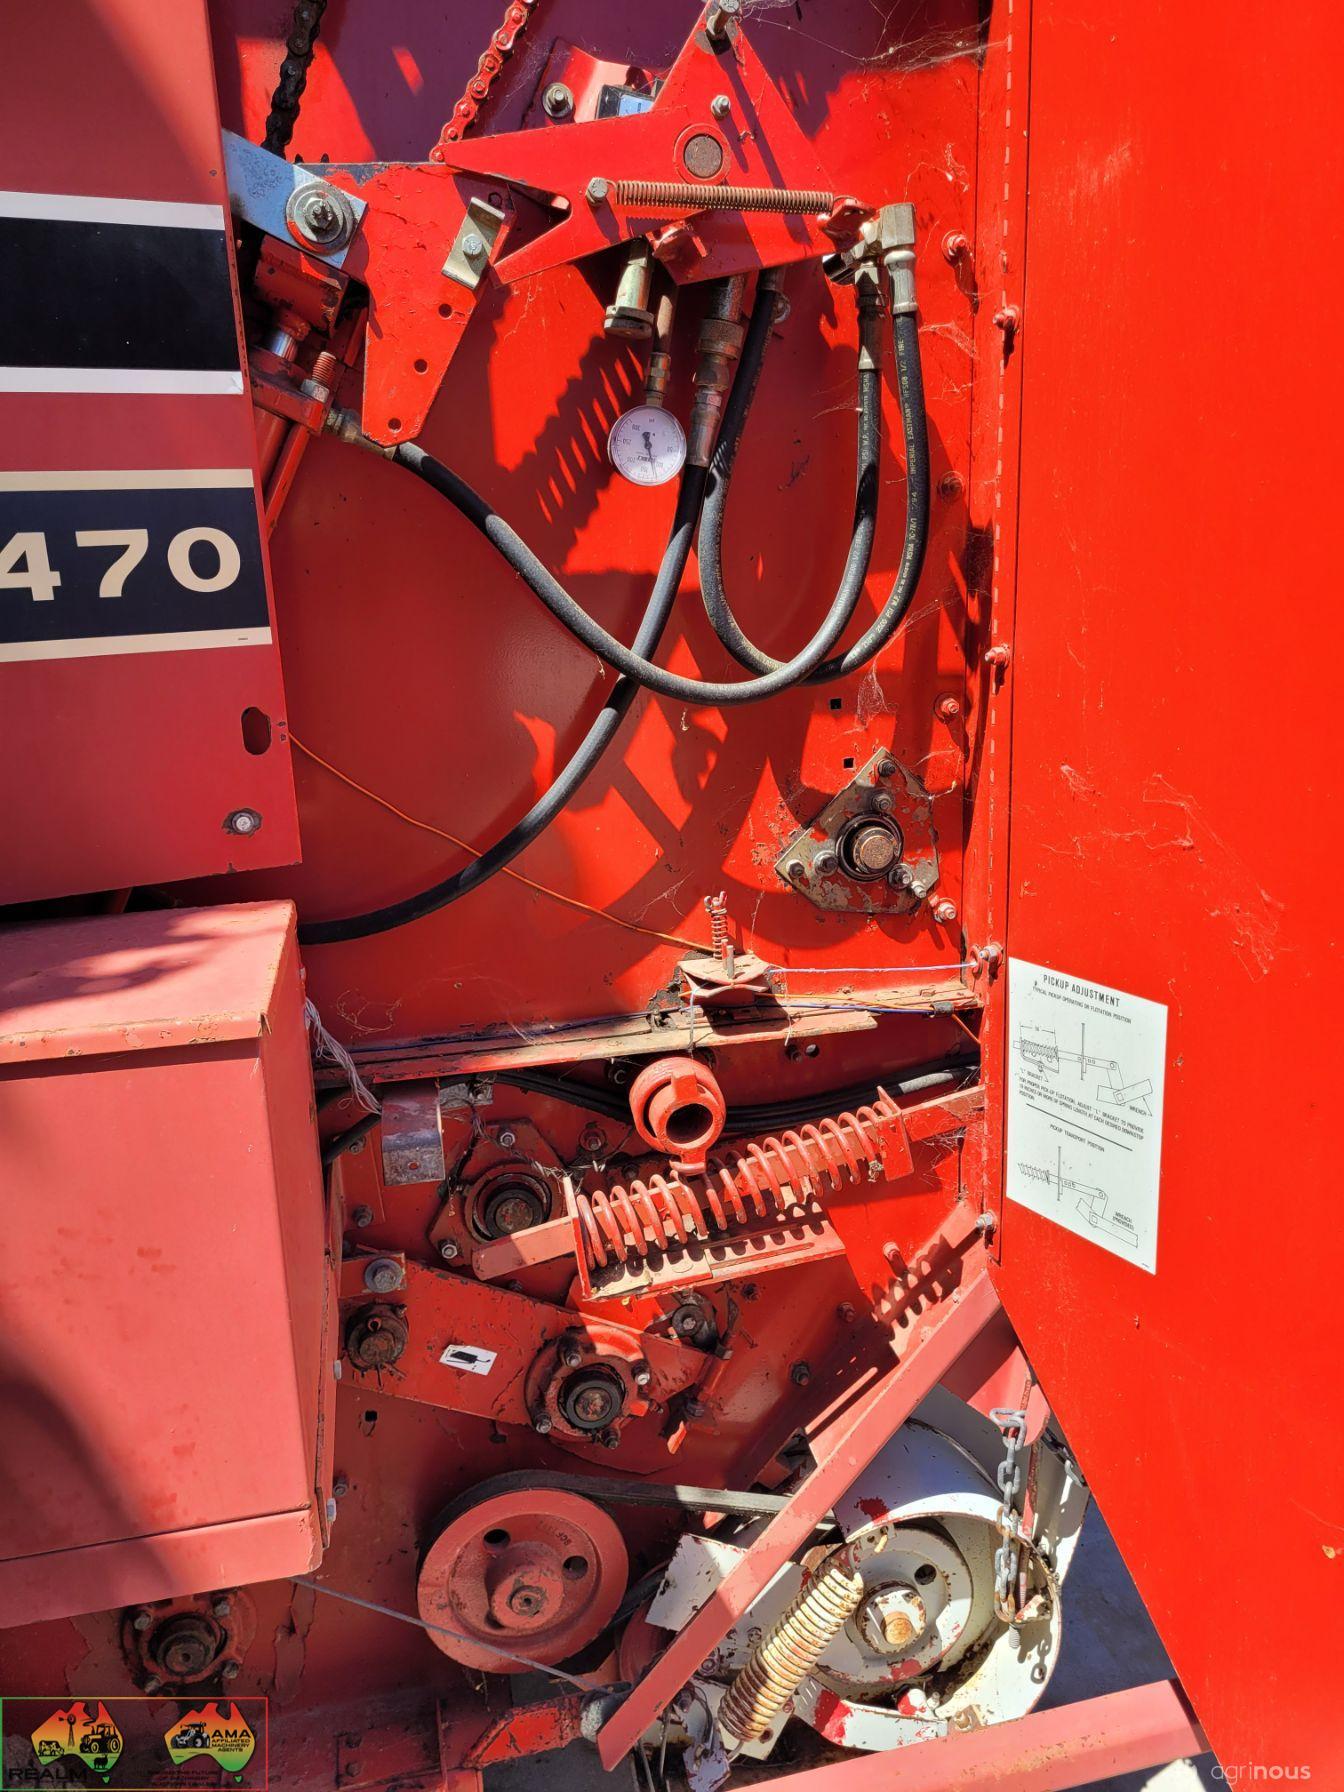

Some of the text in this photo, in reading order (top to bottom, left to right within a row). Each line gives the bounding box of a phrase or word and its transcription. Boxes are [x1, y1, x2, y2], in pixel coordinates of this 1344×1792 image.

[1043, 974, 1121, 1008] PICKUP ADJUSTMENT
[1048, 991, 1062, 1000] PICKUP
[1062, 996, 1084, 1009] OPERATING
[1090, 1004, 1113, 1017] FLOTATION
[1112, 1013, 1132, 1025] POSITION
[1077, 1100, 1092, 1112] ADJUST
[1102, 1111, 1120, 1123] BRACKET
[1129, 1105, 1147, 1117] WRENCH
[1064, 1130, 1086, 1144] TRANSPORT
